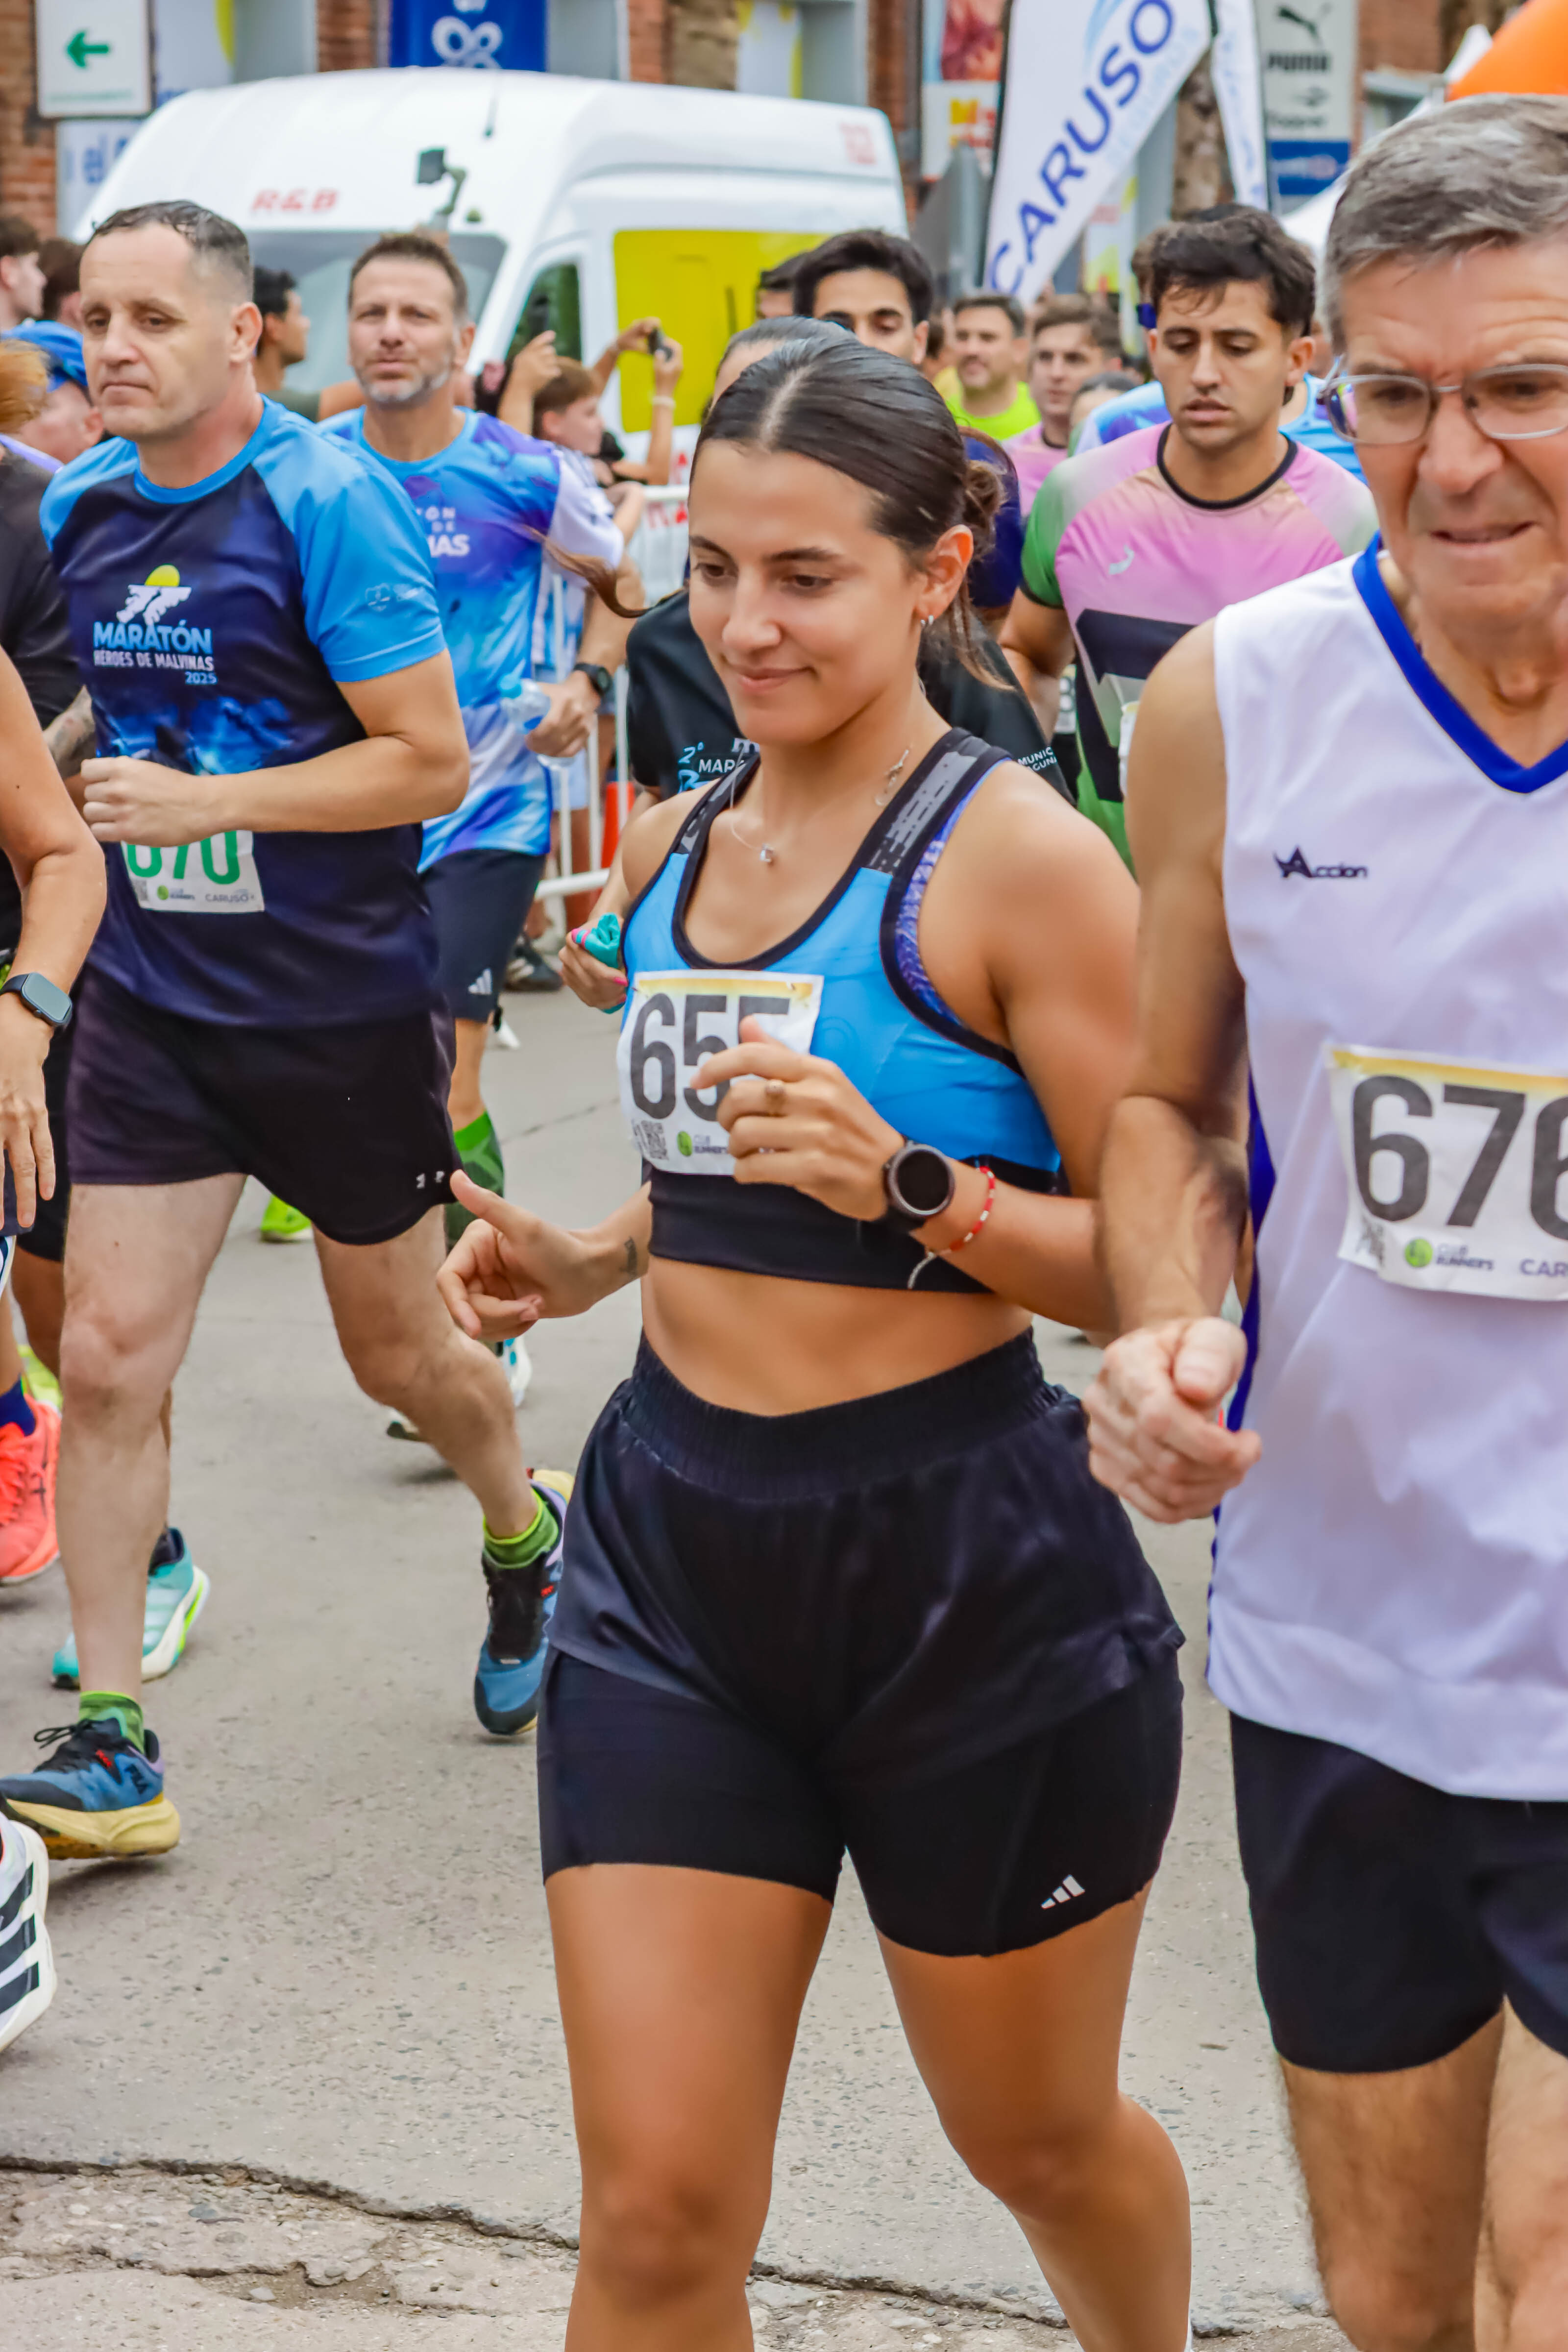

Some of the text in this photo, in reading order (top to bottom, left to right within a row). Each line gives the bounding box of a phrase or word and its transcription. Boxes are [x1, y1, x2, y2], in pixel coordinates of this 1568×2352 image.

[989, 0, 1173, 295] CARUSO
[93, 619, 213, 654] MARATÓN
[136, 652, 152, 667] DE
[154, 653, 214, 671] MALVINAS
[185, 671, 217, 685] 2025
